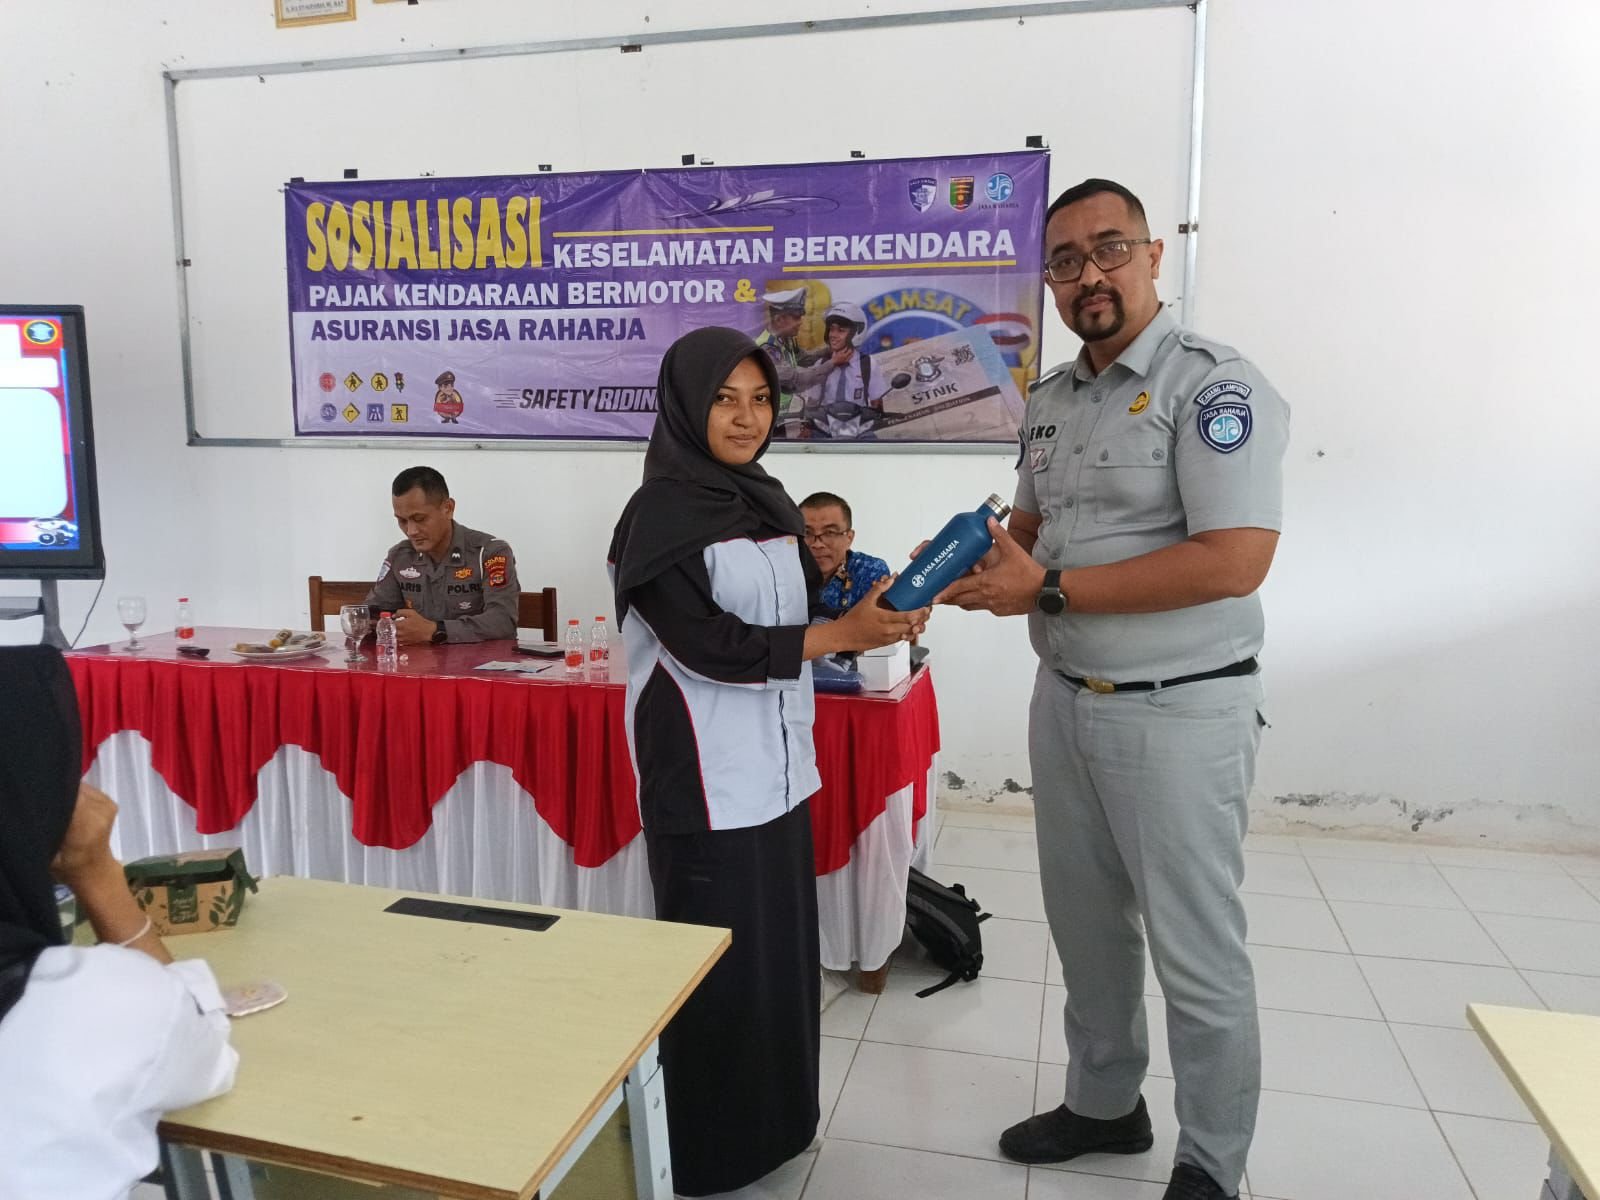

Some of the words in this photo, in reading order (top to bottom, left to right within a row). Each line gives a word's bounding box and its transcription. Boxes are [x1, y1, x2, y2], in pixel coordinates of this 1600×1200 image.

[306, 196, 542, 272] SOSIALISASI
[553, 237, 774, 269] KESELAMATAN
[783, 229, 1016, 263] BERKENDARA
[309, 284, 389, 307] PAJAK
[395, 282, 559, 306] KENDARAAN
[567, 279, 726, 305] BERMOTOR
[734, 279, 757, 303] &
[868, 290, 973, 321] SAMSAT
[311, 319, 440, 341] ASURANSI
[447, 318, 510, 341] JASA
[519, 318, 647, 341] RAHARJA
[519, 388, 595, 410] SAFETY
[597, 388, 658, 410] RIDIN
[911, 383, 959, 404] STNK
[1203, 410, 1218, 421] JASA
[1030, 424, 1056, 441] EKO
[921, 562, 936, 577] JASA
[934, 540, 960, 563] RAHARJA
[447, 583, 482, 594] POLRI
